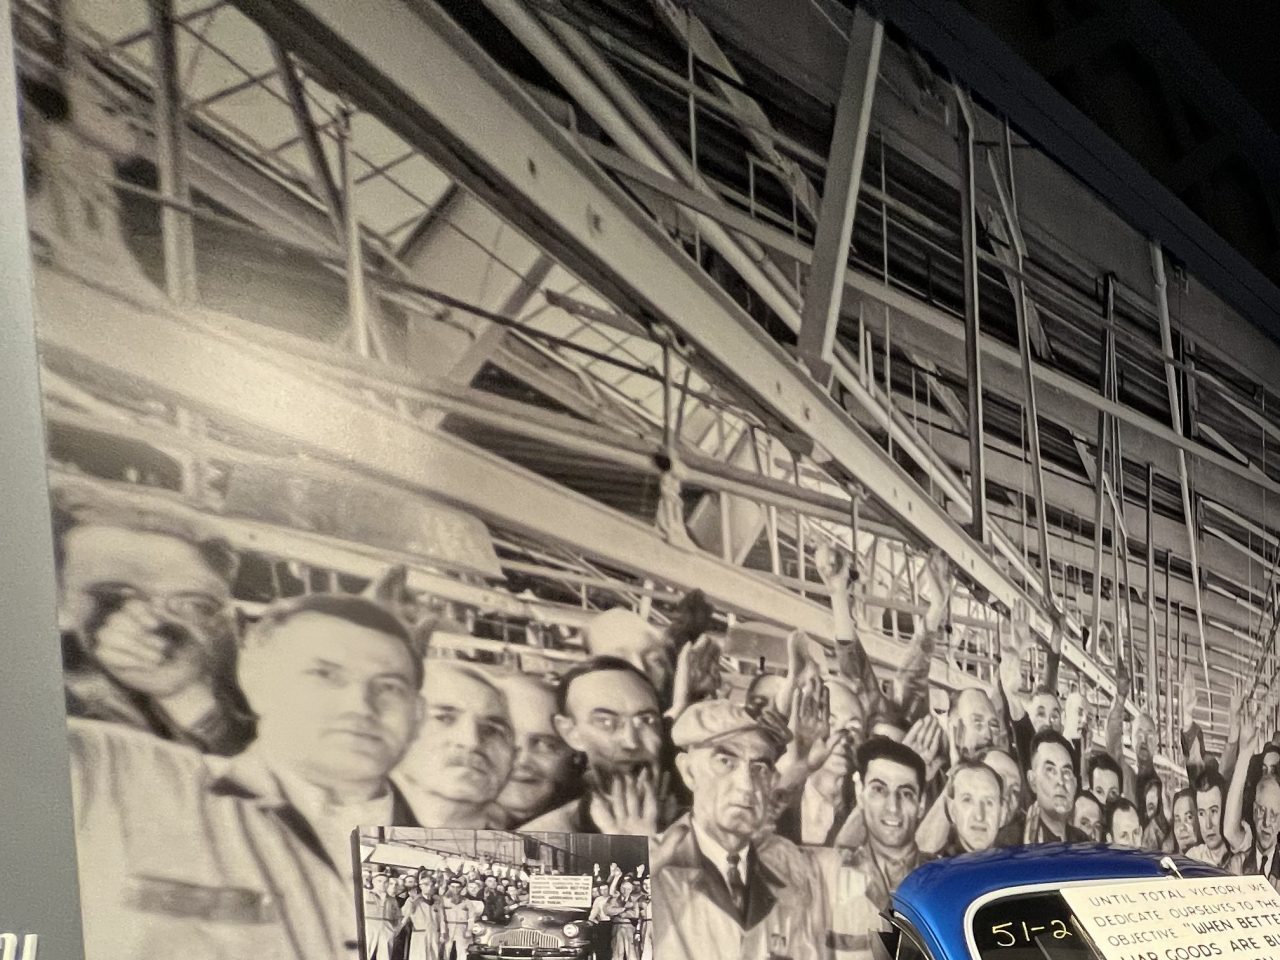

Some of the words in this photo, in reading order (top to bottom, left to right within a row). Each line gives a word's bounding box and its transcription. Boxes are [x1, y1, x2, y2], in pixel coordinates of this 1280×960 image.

[1088, 893, 1137, 907] UNTIL
[1140, 889, 1186, 902] TOTAL
[1248, 883, 1266, 893] WE
[1093, 910, 1164, 928] DEDICATE
[1168, 902, 1236, 919] OURSELVES
[1237, 900, 1254, 910] TO
[1256, 898, 1280, 909] THE
[992, 920, 1073, 947] 51-2
[1107, 928, 1179, 947] OBJECTIVE
[1229, 937, 1259, 952] ARE
